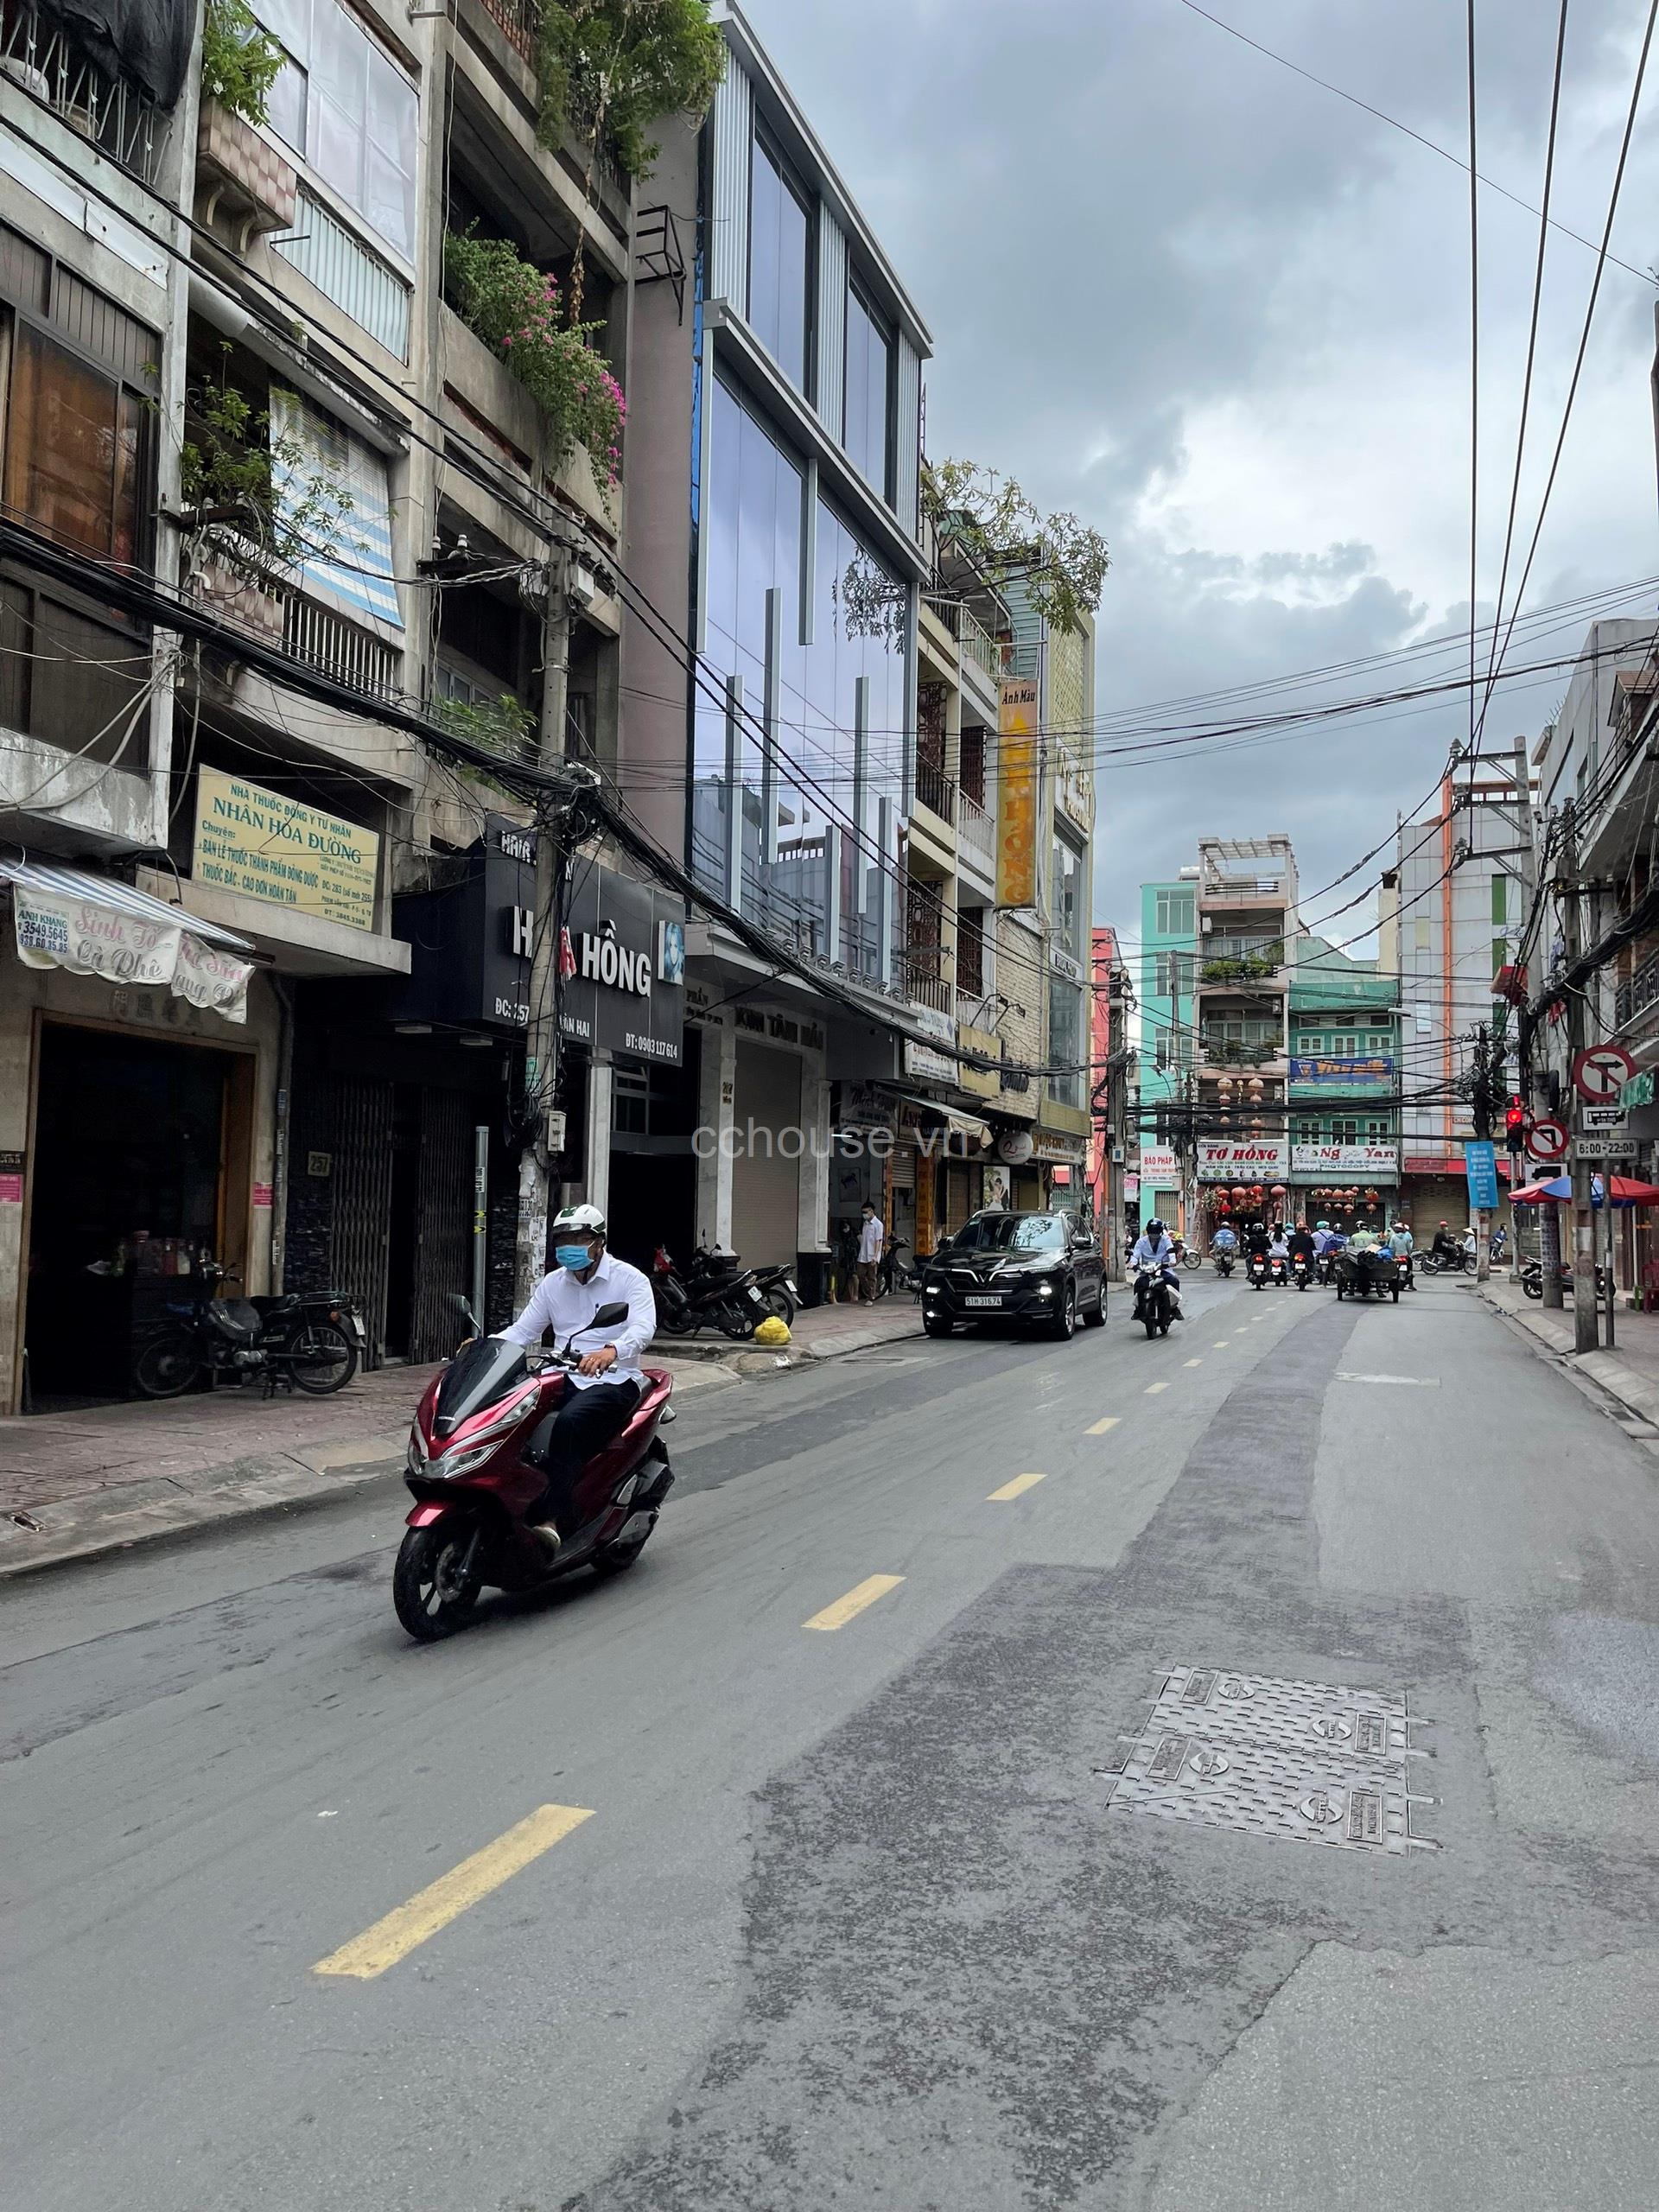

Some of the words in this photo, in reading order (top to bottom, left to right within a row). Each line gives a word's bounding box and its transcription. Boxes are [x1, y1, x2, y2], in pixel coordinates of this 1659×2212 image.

[201, 819, 236, 838] Chuyên:
[213, 797, 264, 830] NHÂN
[269, 817, 302, 844] HÒA
[308, 831, 361, 864] ĐƯỜNG
[310, 813, 315, 825] Y
[40, 914, 67, 929] KHANG
[111, 948, 162, 978] Phê
[582, 919, 652, 998] HỒNG
[495, 997, 512, 1018] ĐC:
[576, 1019, 590, 1038] HAI
[1206, 1147, 1229, 1160] TƠ
